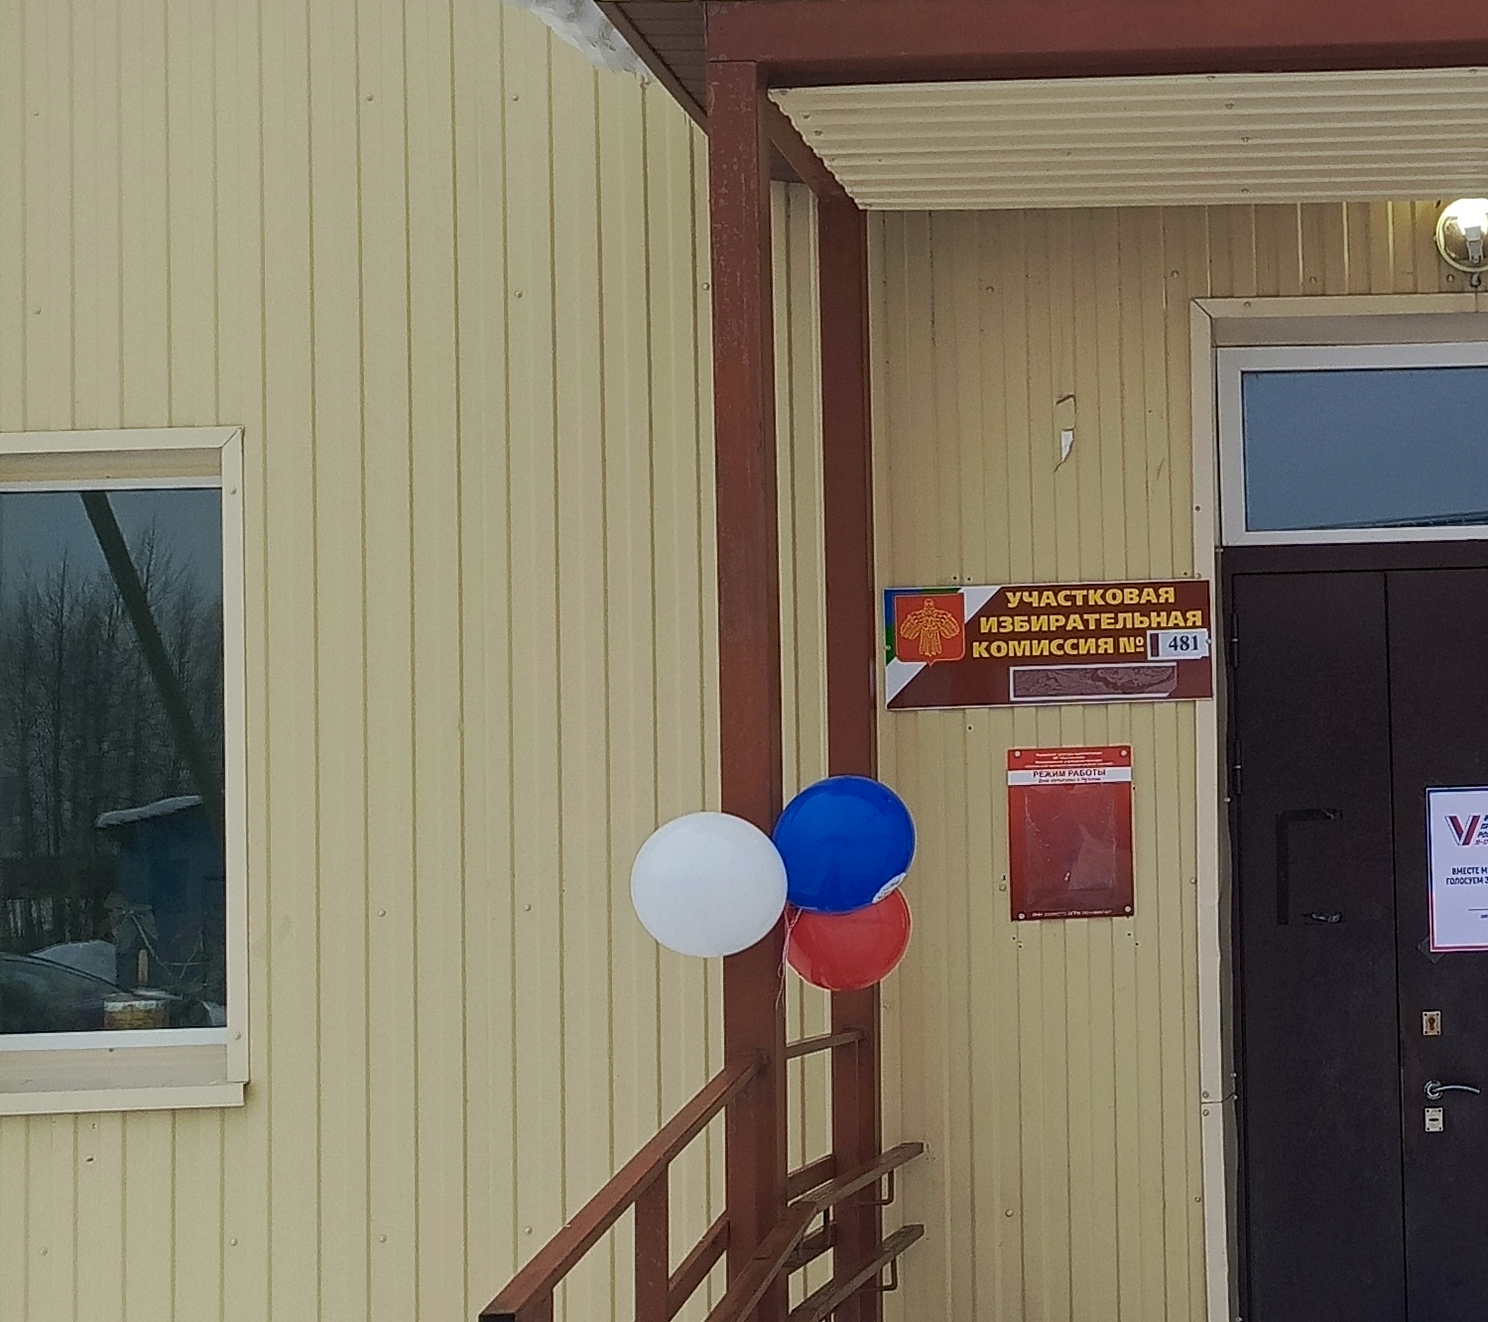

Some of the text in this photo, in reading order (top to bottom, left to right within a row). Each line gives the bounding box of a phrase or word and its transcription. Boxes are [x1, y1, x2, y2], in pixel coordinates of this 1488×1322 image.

[1006, 587, 1176, 609] УЧАСТКОВАЯ
[979, 610, 1203, 634] ИЗБИРАТЕЛЬНАЯ
[972, 636, 1114, 658] КОМИССИЯ
[1168, 634, 1199, 652] 481
[1033, 768, 1106, 778] РЕЖИМ РАБОТЫ
[1452, 866, 1479, 875] ВМЕСТЕ
[1446, 876, 1483, 885] ГОЛОСУЕМ
